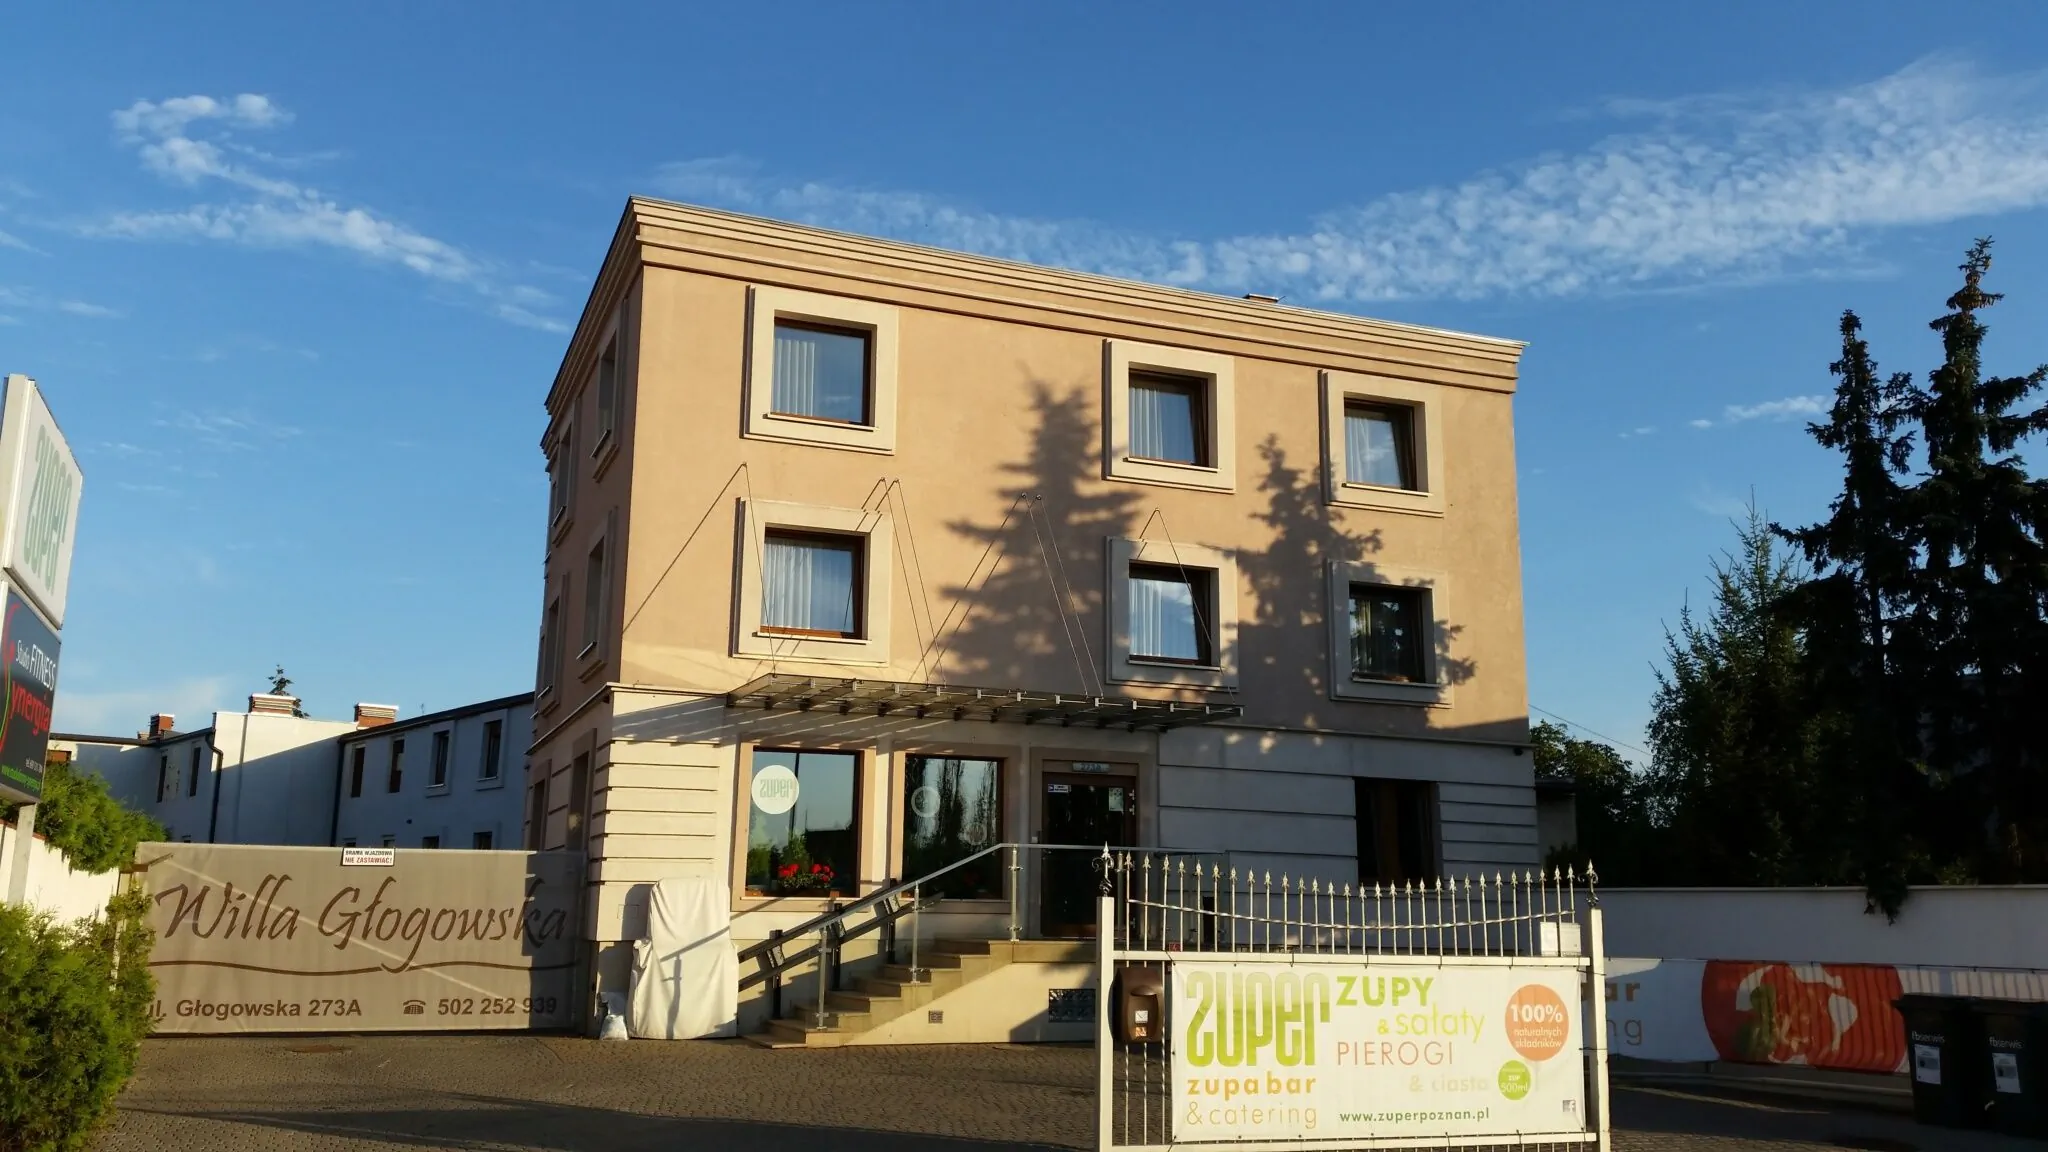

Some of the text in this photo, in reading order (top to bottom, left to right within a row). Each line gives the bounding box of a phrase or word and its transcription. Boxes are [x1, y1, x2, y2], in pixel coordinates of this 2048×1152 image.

[29, 644, 56, 691] FITNESS
[155, 874, 567, 973] Willa Głogowska
[1336, 976, 1433, 1006] ZUPY
[176, 999, 300, 1020] Głogowska
[308, 1000, 362, 1017] 273A
[438, 997, 557, 1015] 502 252 939
[1510, 1004, 1563, 1022] 100%
[1377, 1003, 1485, 1043] & sałaty
[1514, 1026, 1562, 1038] naturalnych
[1337, 1041, 1453, 1065] PIEROGI
[1340, 1107, 1489, 1124] www.zuperpoznan.pl
